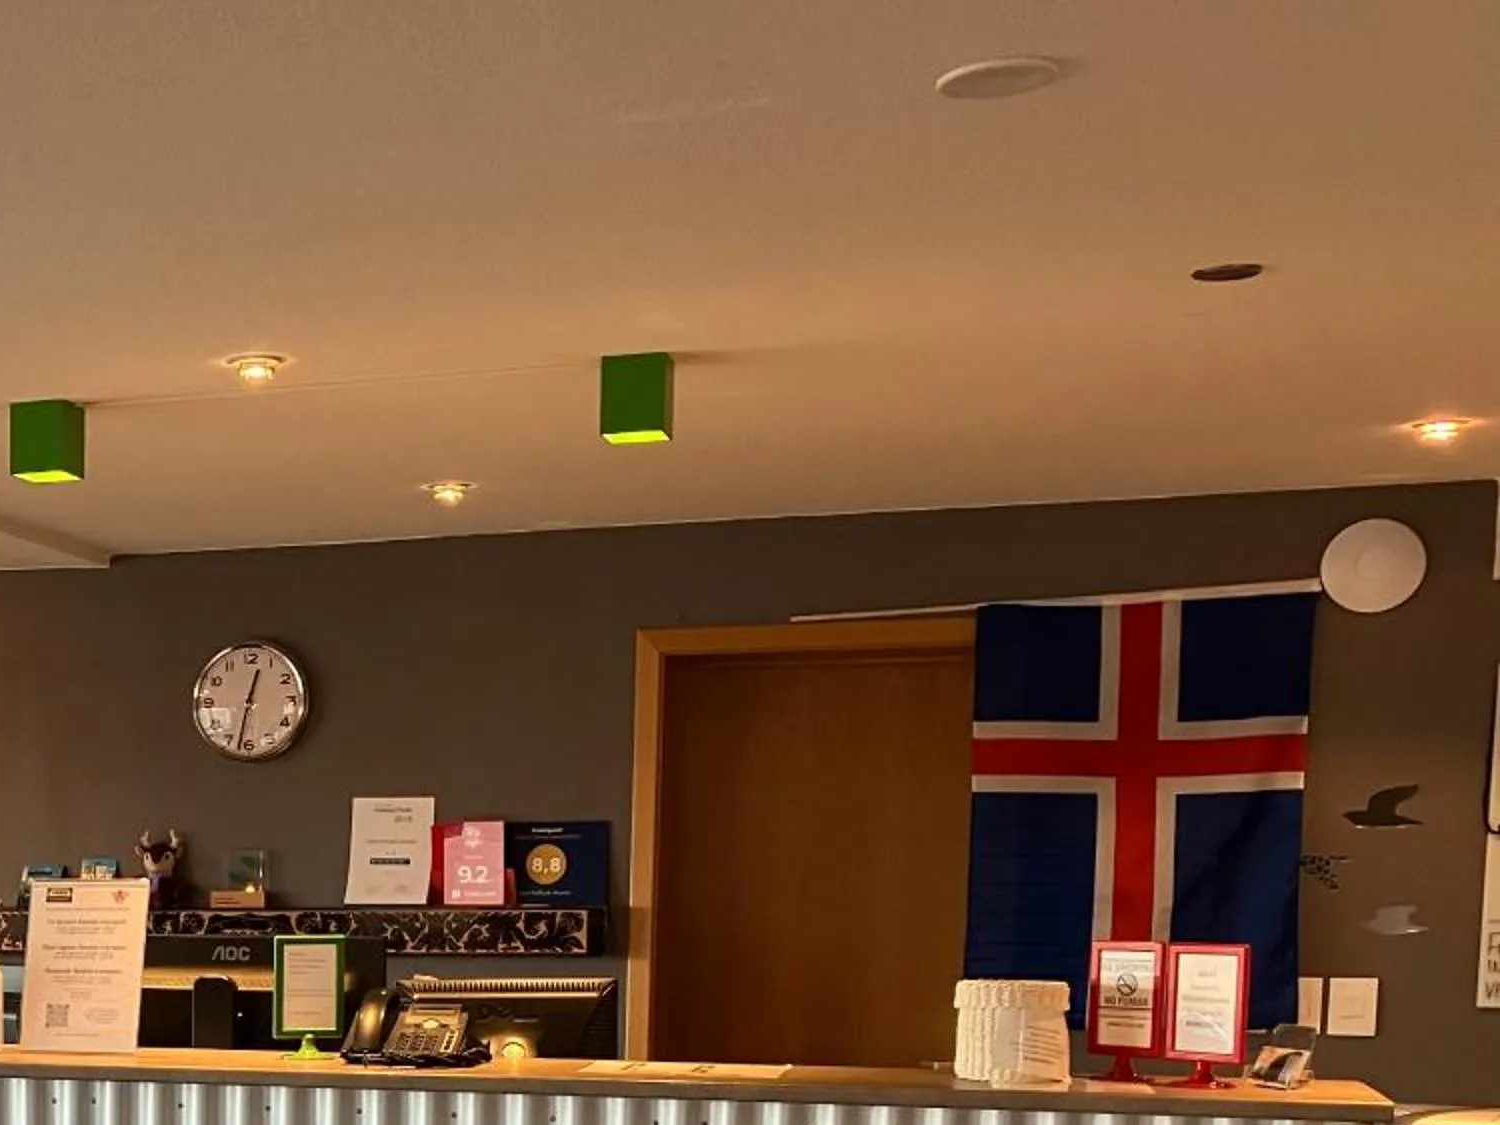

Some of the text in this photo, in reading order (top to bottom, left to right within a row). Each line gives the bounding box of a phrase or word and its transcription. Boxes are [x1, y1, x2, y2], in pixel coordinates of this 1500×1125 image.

[244, 653, 259, 665] 12
[280, 673, 291, 685] 2
[203, 697, 214, 709] 9
[280, 716, 290, 727] 4
[243, 739, 255, 751] 6
[531, 857, 561, 875] 8,8
[211, 945, 251, 961] AOC
